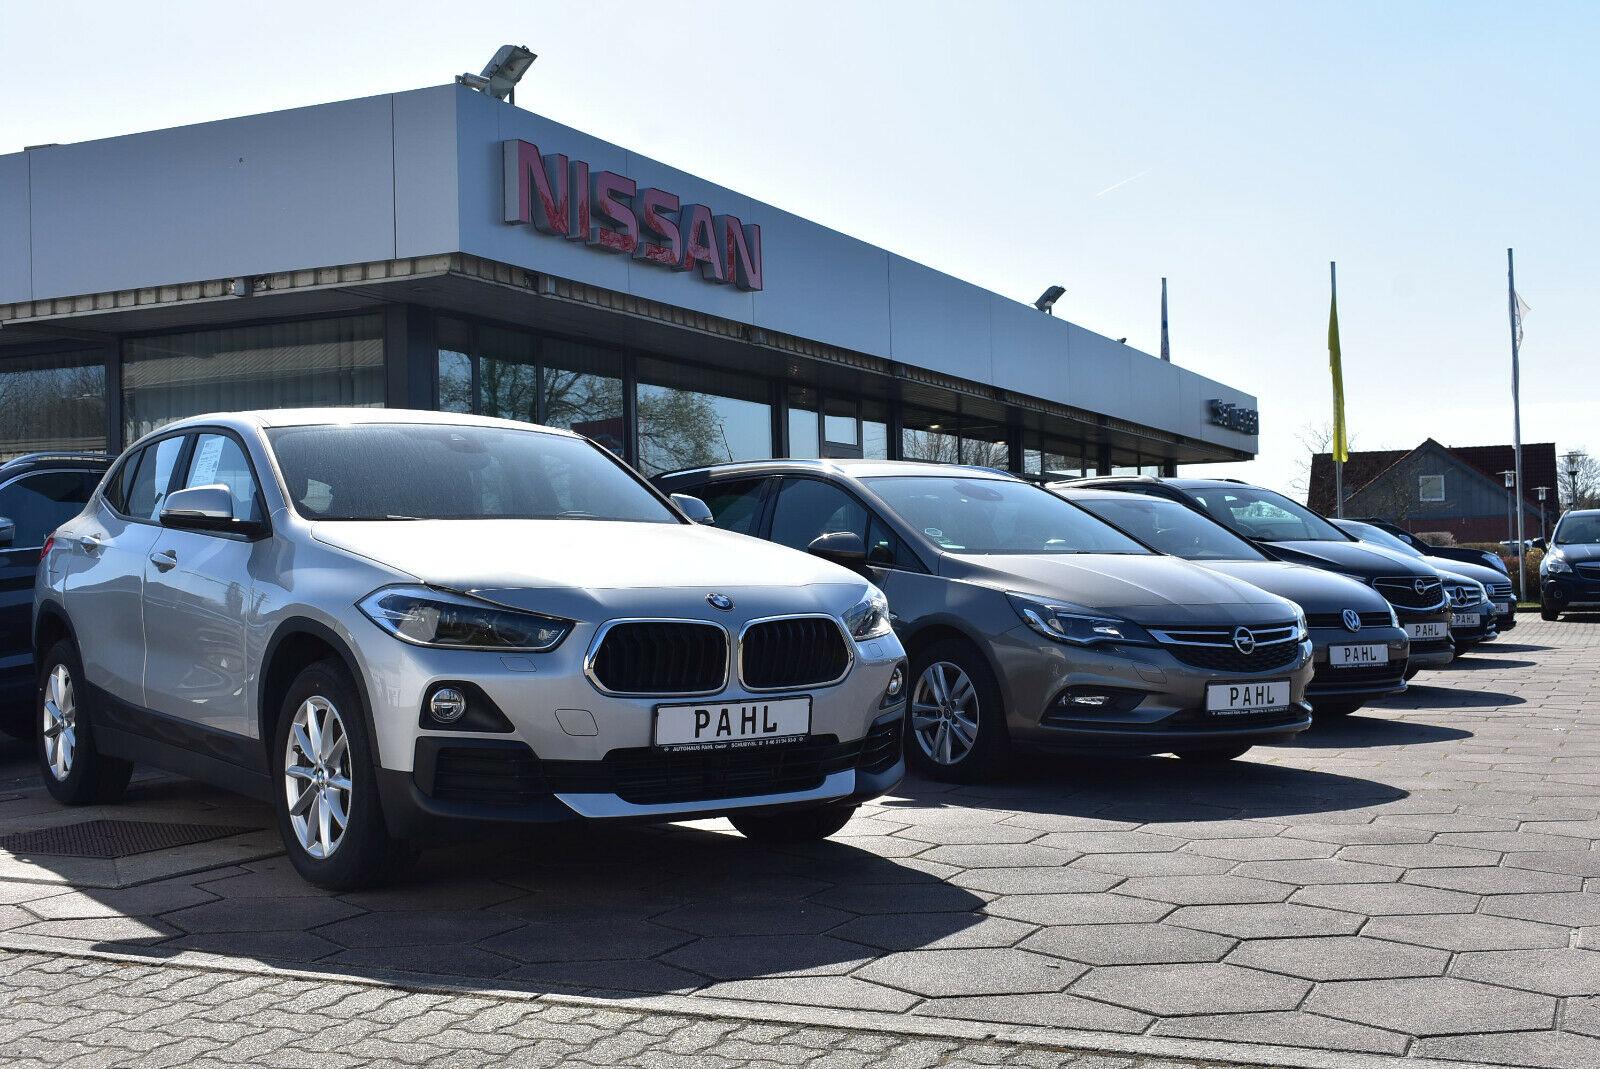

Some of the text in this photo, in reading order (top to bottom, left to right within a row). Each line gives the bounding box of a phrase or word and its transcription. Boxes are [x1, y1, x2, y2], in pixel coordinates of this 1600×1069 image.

[504, 139, 763, 291] NISSAN
[1456, 614, 1475, 624] PAHL
[1415, 624, 1439, 636] PAHL
[1344, 646, 1377, 662] PAHL
[1229, 685, 1275, 706] PAHL
[694, 705, 778, 738] PAHL
